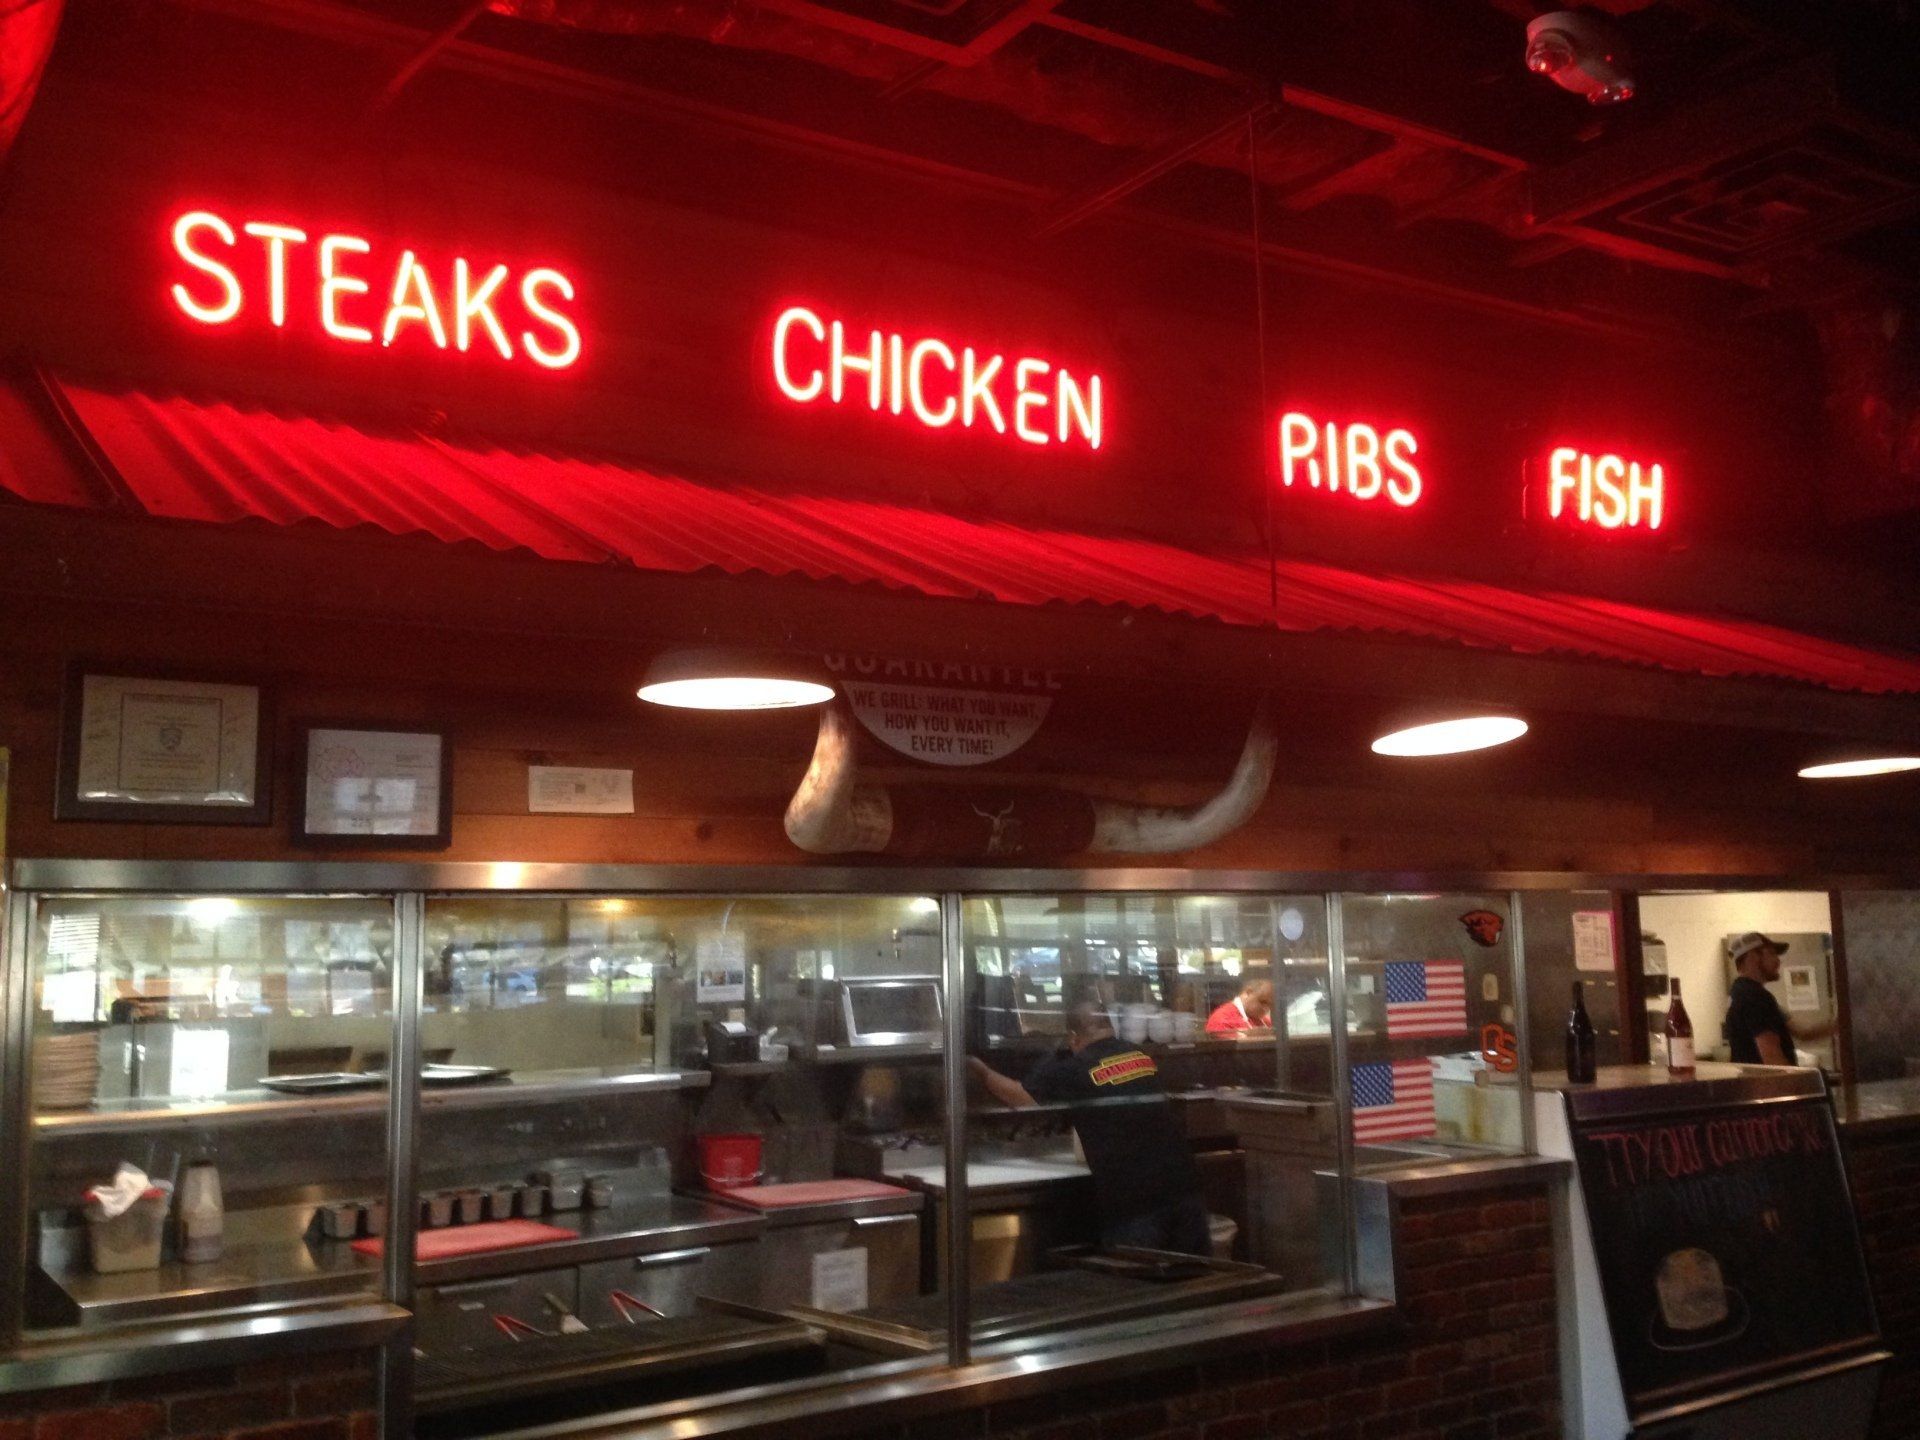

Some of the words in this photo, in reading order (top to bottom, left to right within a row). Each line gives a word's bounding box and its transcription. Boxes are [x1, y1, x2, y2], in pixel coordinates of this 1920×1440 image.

[172, 210, 582, 369] STEAKS
[772, 306, 1102, 450] CHICKEN
[1279, 411, 1422, 507] RIBS
[1548, 445, 1664, 530] FISH
[853, 688, 876, 708] WE
[927, 694, 965, 714] WHAT
[969, 698, 996, 716] YOU
[884, 711, 917, 730] HOW
[922, 715, 950, 733] YOU
[953, 717, 992, 736] WANT
[911, 735, 953, 753] EVERY
[957, 738, 994, 756] TIME!
